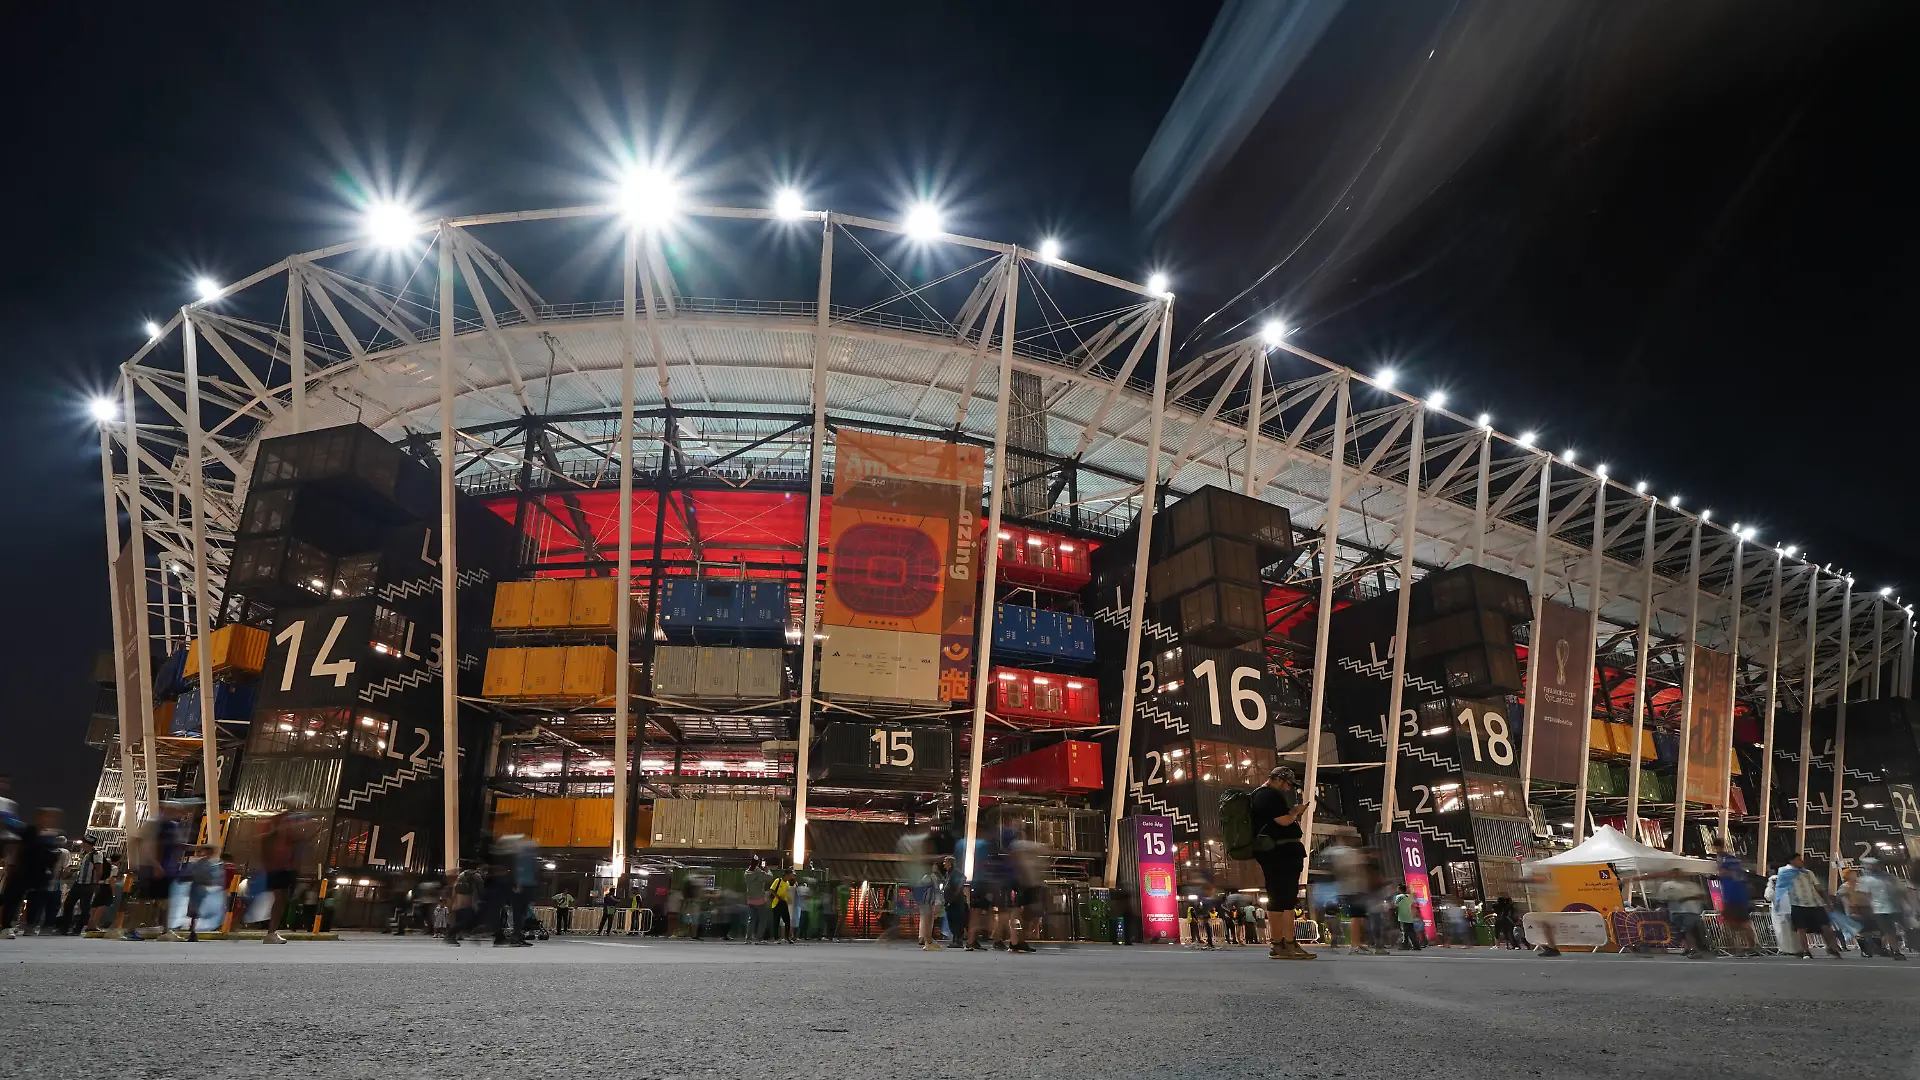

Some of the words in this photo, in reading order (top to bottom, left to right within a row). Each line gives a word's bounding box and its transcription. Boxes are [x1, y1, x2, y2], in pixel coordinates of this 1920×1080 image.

[949, 509, 977, 580] azing
[275, 615, 356, 691] 14
[404, 621, 443, 669] L3
[1192, 659, 1267, 731] 16
[387, 719, 430, 763] L2
[870, 731, 915, 767] 15
[1457, 708, 1514, 766] 18
[1128, 750, 1164, 790] L2
[1394, 784, 1432, 818] L2
[367, 825, 415, 868] L1
[1143, 832, 1166, 856] 15
[1405, 846, 1421, 868] 16
